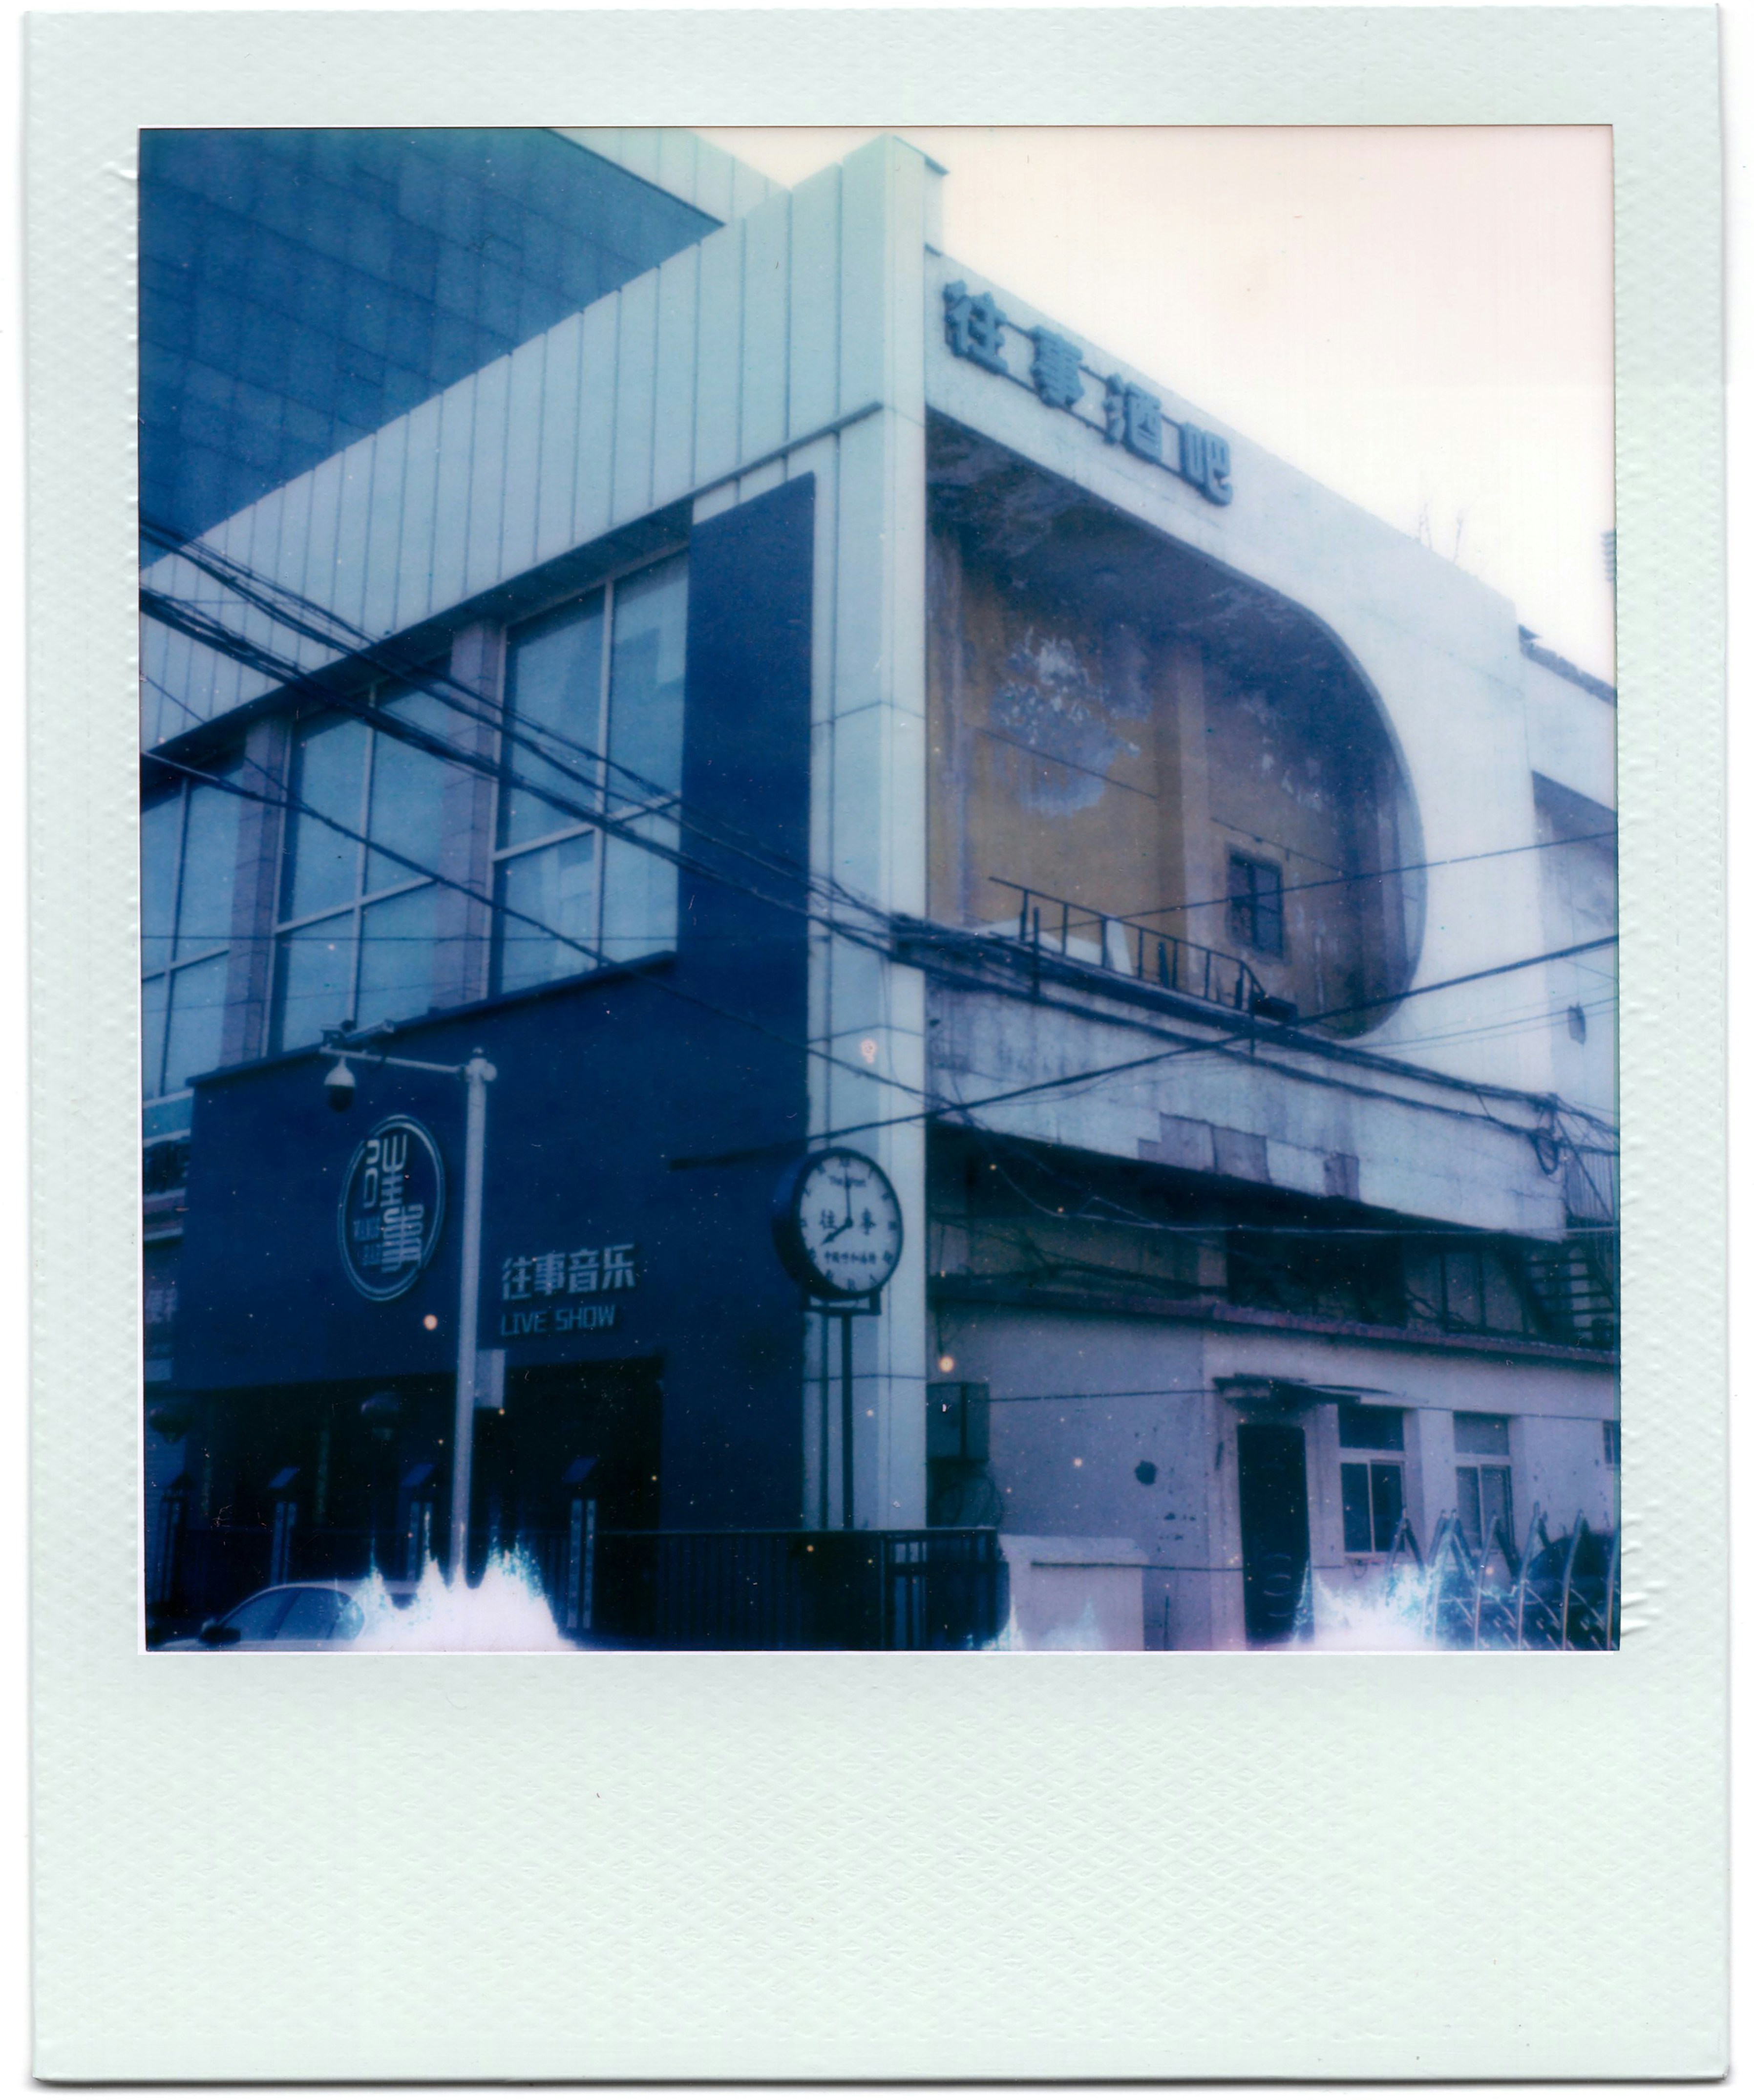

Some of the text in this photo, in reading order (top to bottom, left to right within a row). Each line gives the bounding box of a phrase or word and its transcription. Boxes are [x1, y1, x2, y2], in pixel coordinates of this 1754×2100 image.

[942, 279, 1233, 507] 往事酒吧
[501, 1244, 635, 1301] 往事音乐
[501, 1303, 615, 1336] LIVE SHOW
